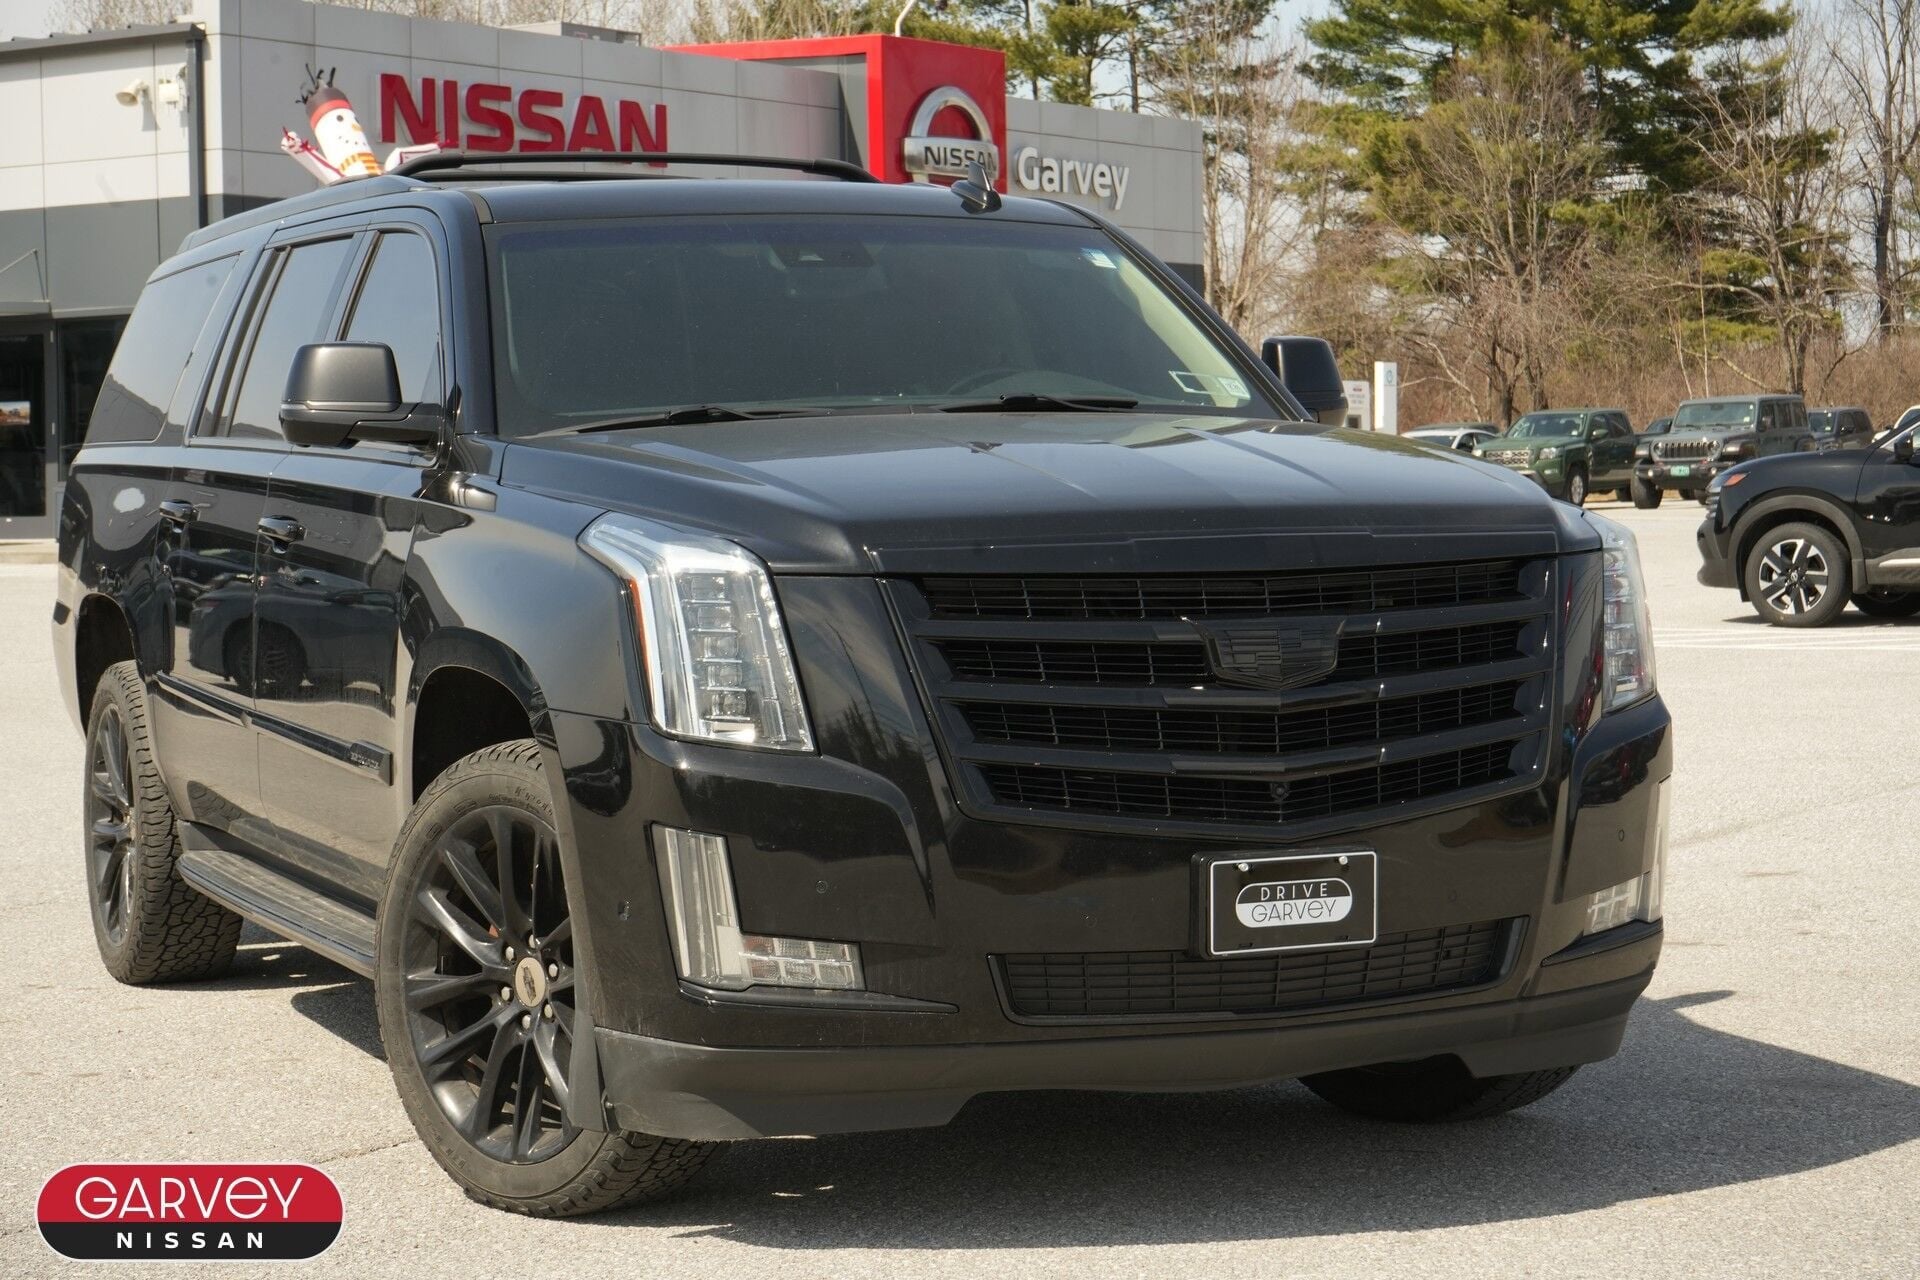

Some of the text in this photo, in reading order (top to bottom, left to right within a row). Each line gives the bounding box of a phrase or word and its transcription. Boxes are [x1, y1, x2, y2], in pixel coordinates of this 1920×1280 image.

[379, 73, 668, 168] NISSAN
[1017, 147, 1130, 210] Garvey
[1260, 883, 1328, 901] DRIVE
